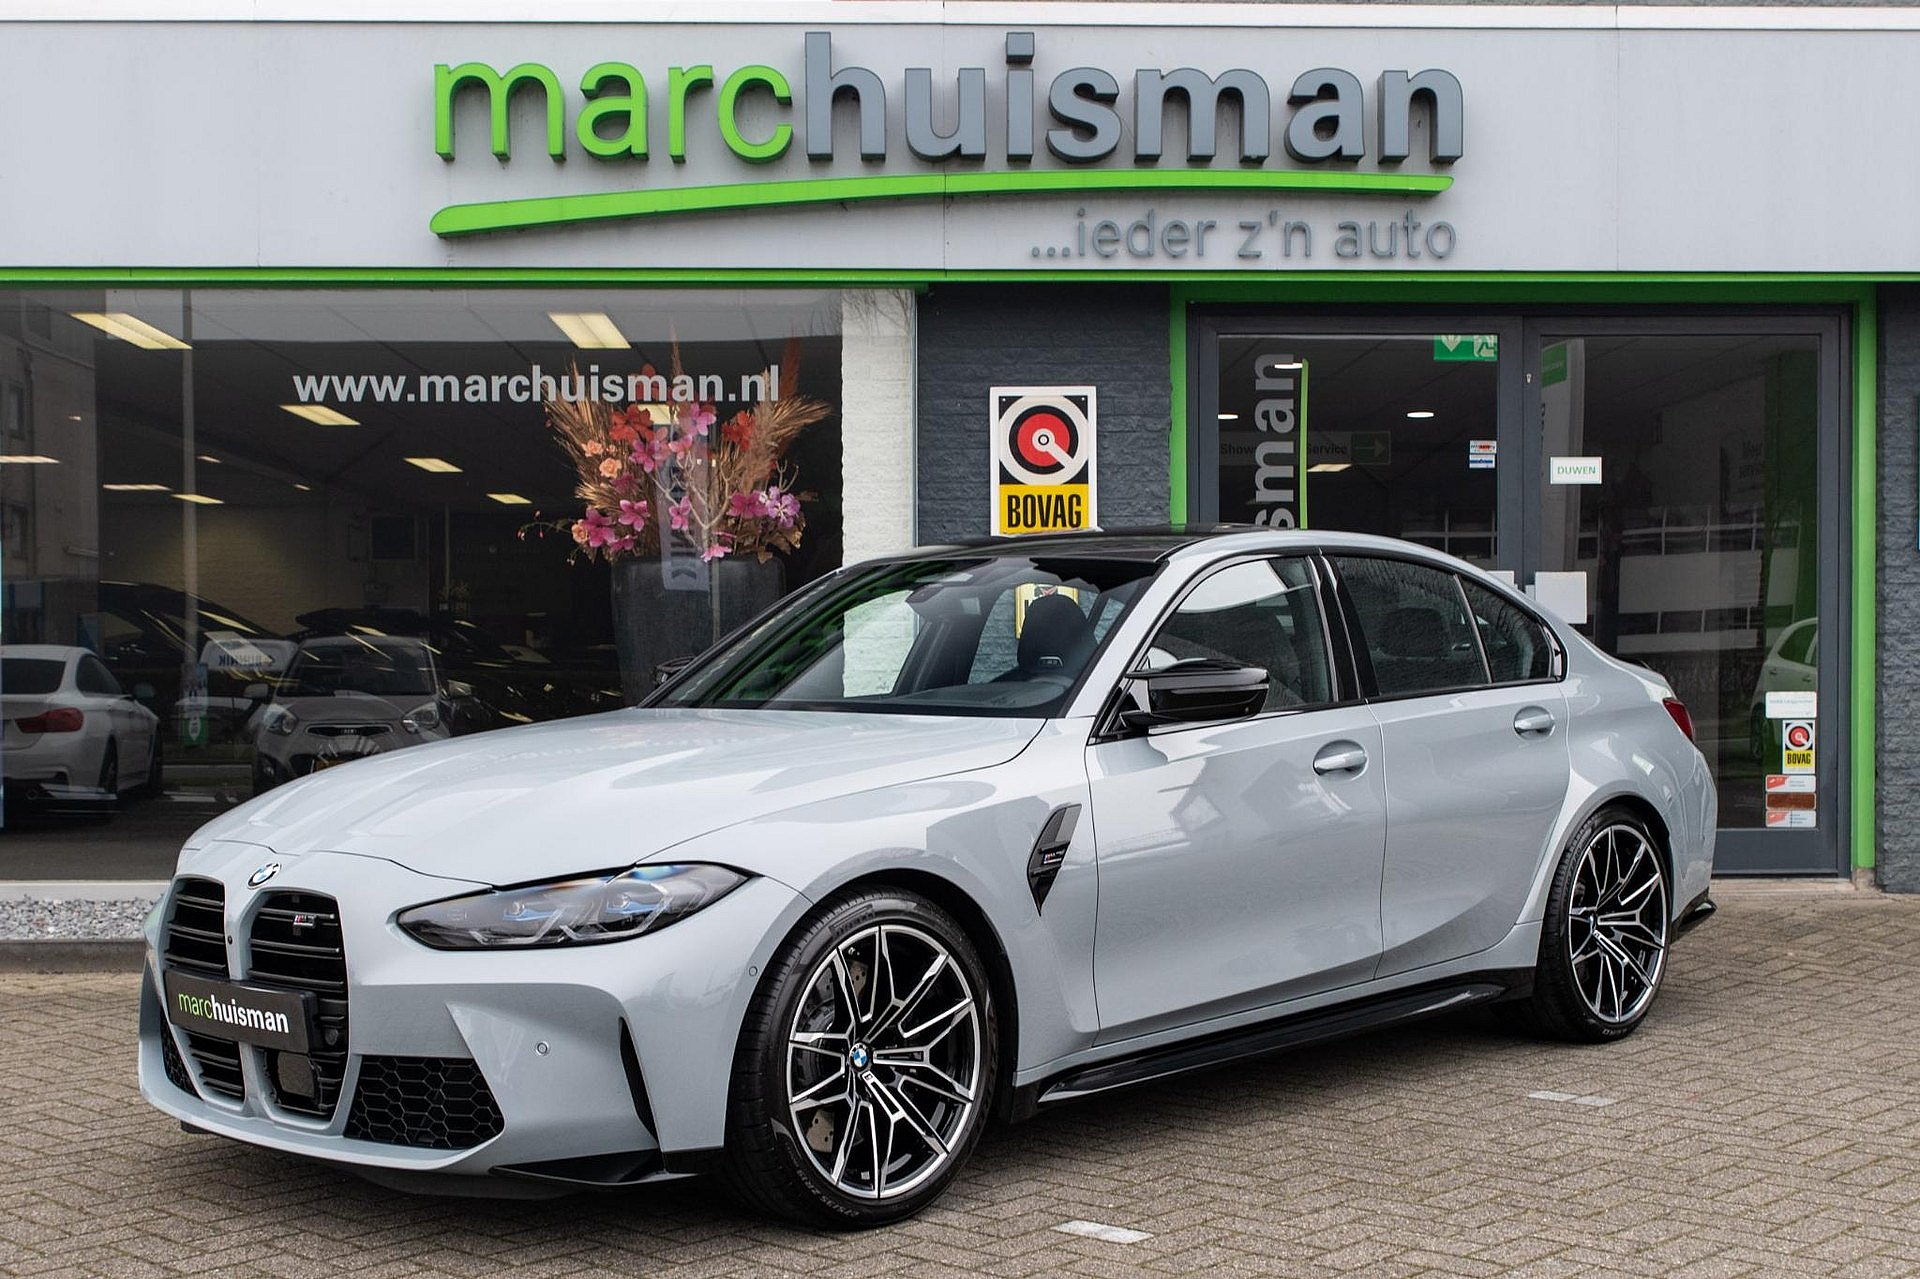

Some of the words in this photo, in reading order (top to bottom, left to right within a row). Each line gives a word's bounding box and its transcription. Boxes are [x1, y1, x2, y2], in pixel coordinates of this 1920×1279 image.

[434, 32, 1463, 164] marchuisman
[1237, 209, 1313, 258] z'n
[1334, 209, 1457, 260] auto
[292, 363, 779, 403] www.marchuisman.nl
[1556, 465, 1597, 476] DUWEN
[1007, 493, 1082, 529] BOVAG
[1786, 752, 1811, 765] BOVAG
[178, 993, 289, 1033] marchuisman
